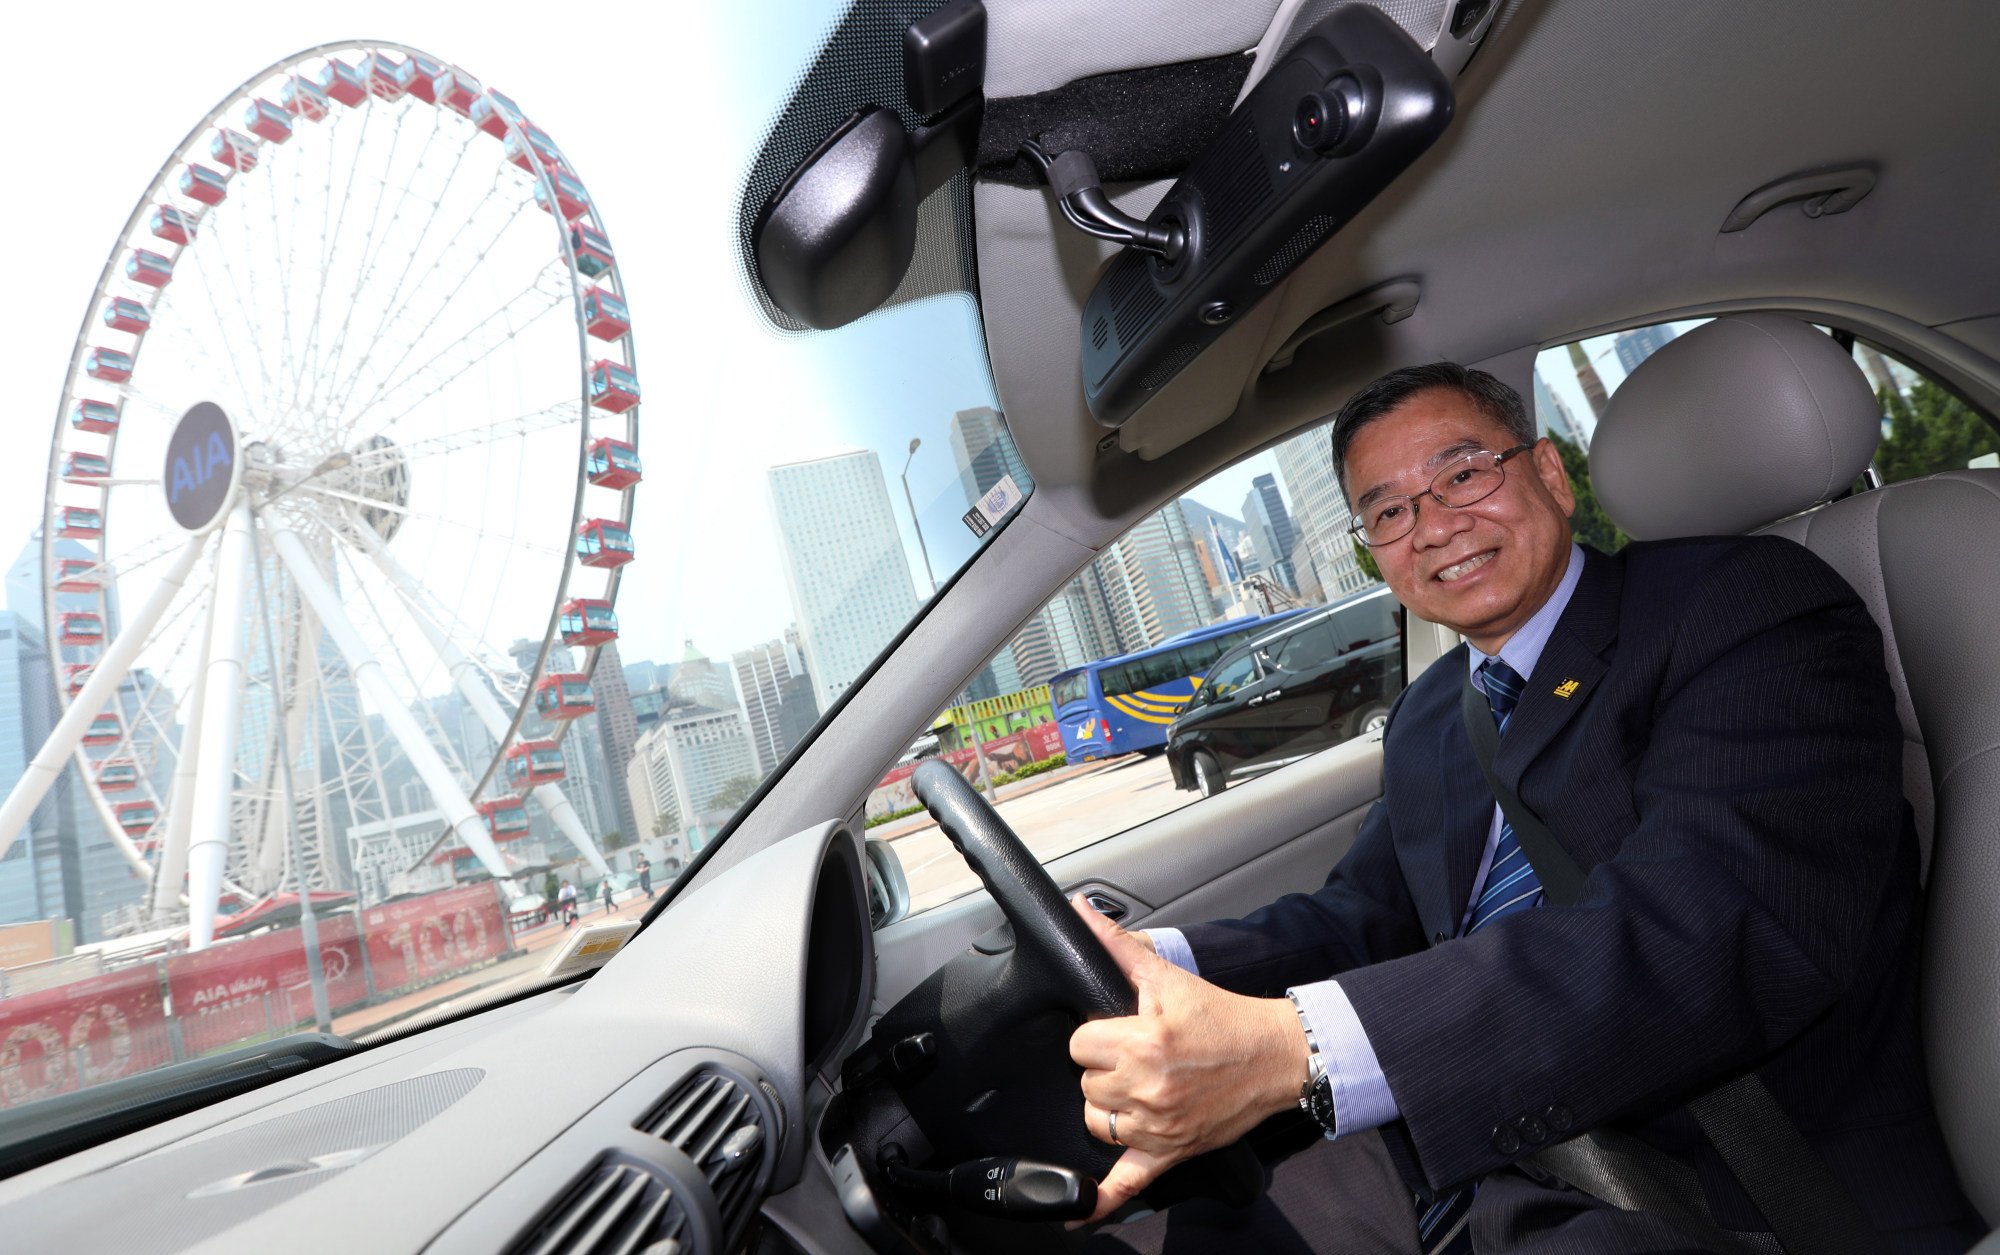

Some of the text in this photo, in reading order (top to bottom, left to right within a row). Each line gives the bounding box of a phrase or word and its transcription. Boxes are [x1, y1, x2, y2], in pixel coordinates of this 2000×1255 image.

[171, 431, 231, 505] AIA
[387, 906, 488, 981] 100
[192, 984, 229, 1006] AIA
